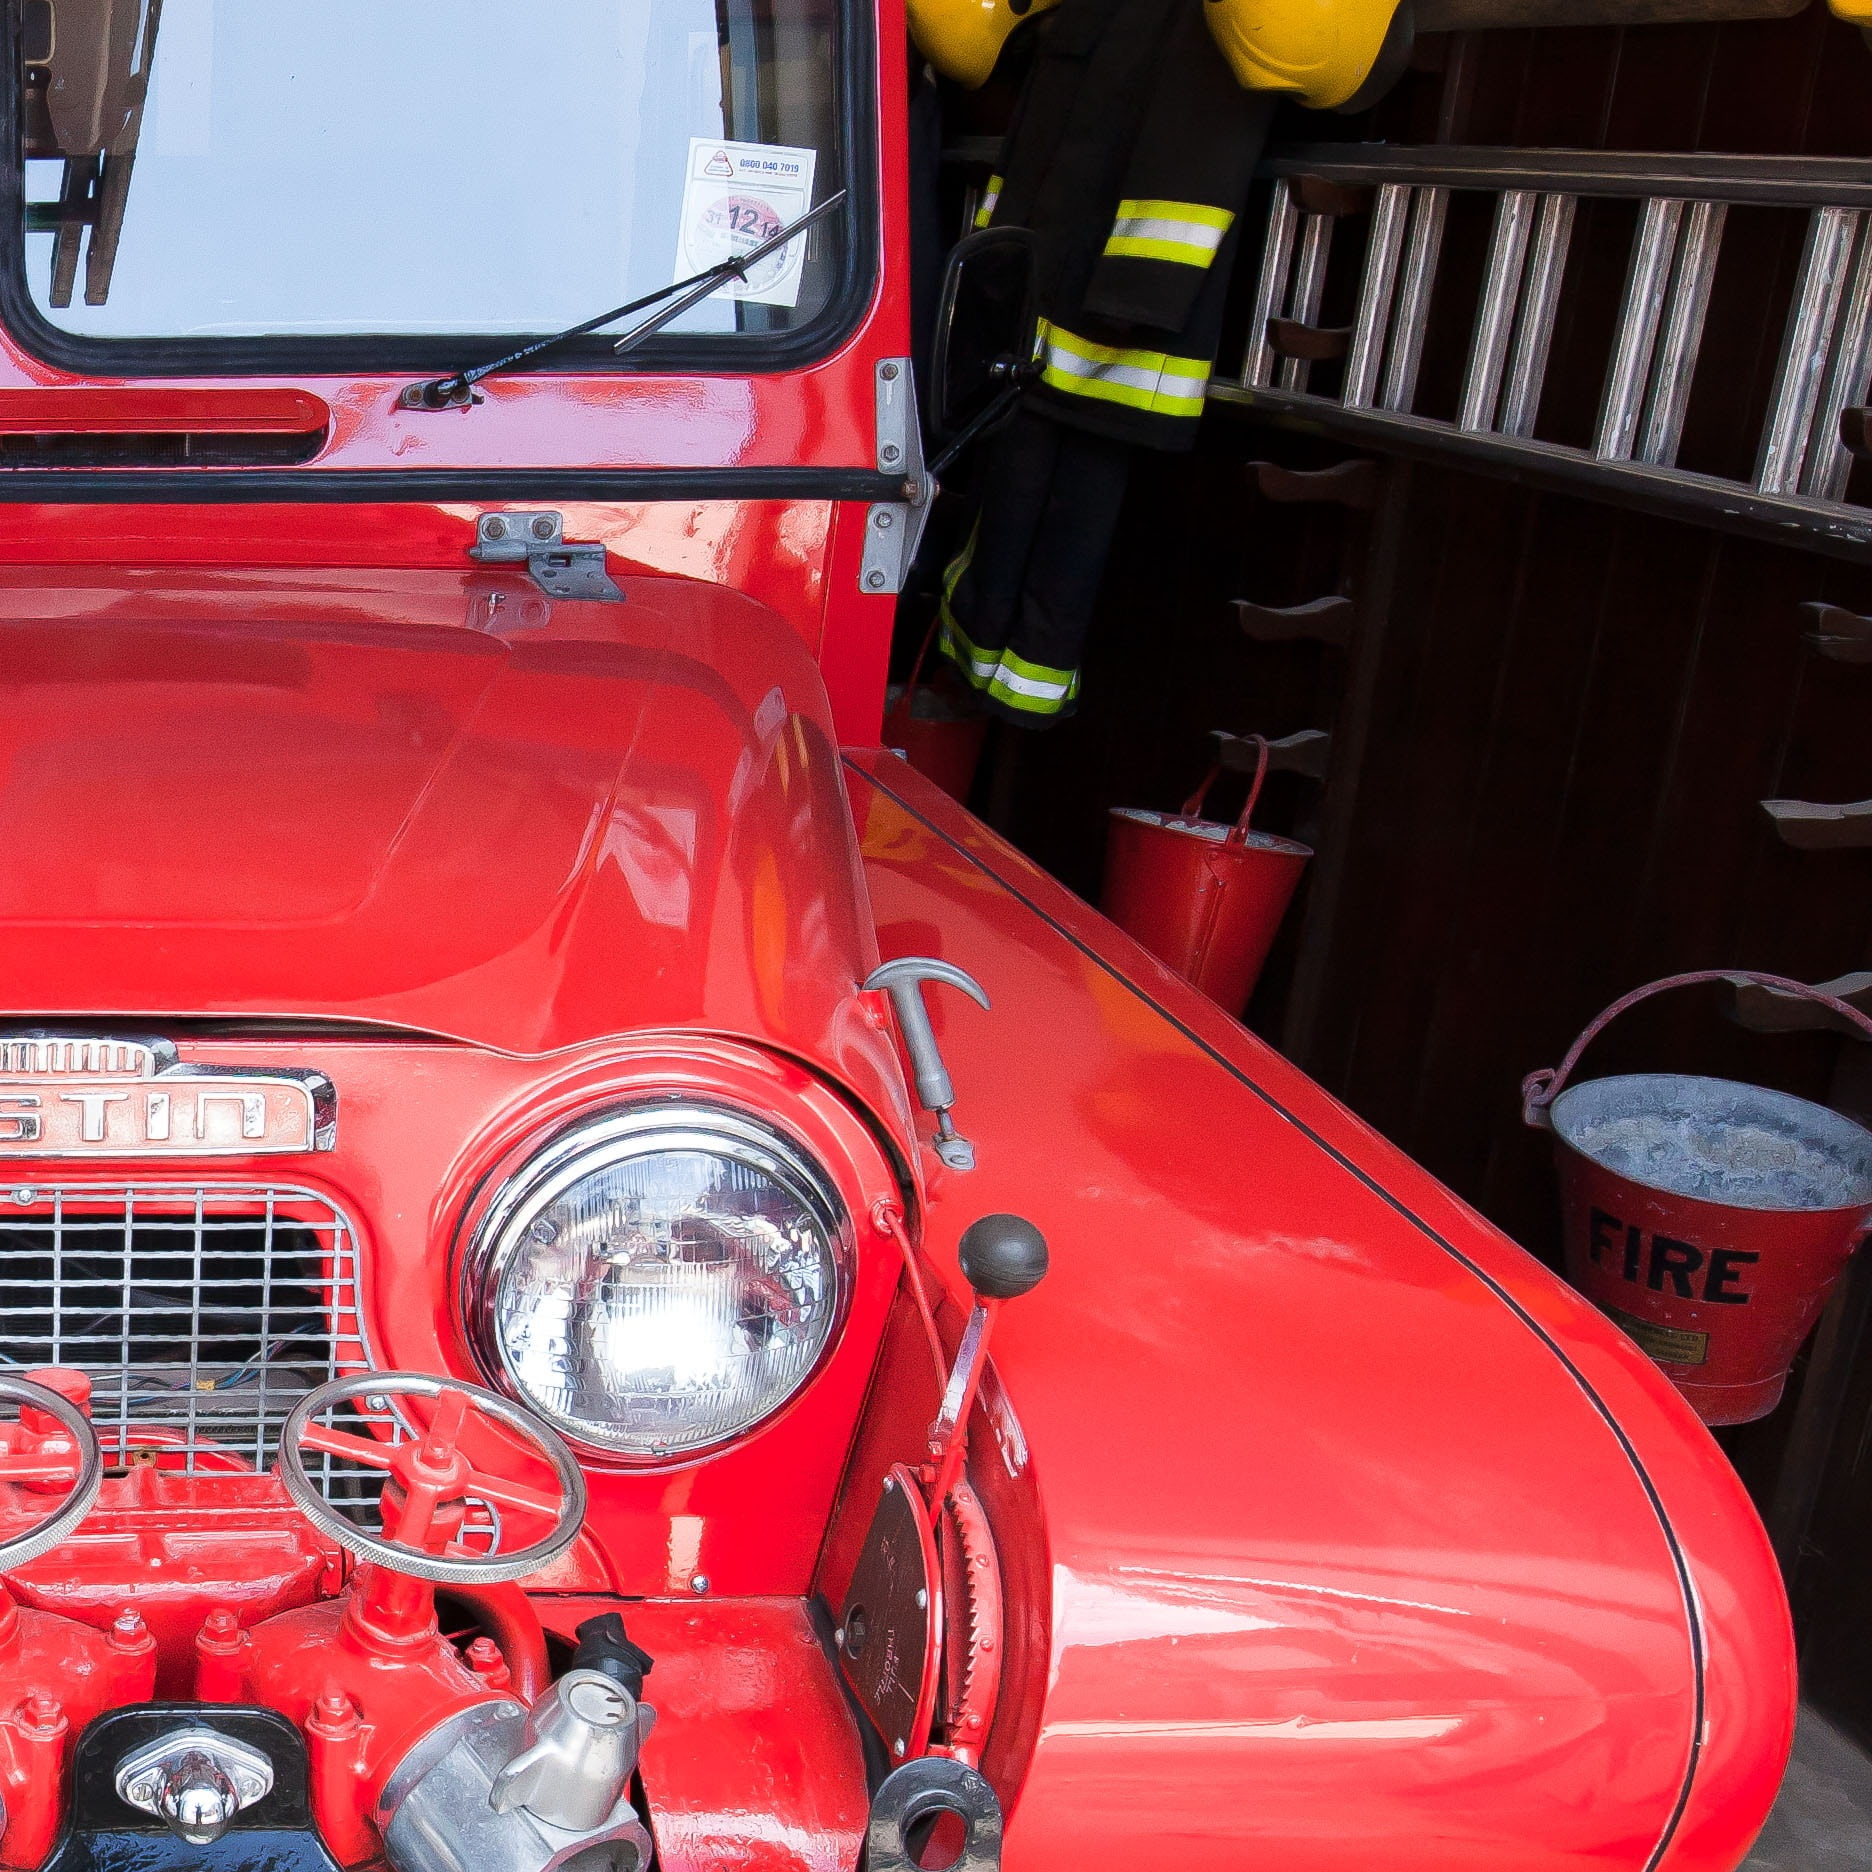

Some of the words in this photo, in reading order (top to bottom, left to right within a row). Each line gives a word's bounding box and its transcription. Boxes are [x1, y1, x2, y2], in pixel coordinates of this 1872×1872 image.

[762, 161, 778, 171] 040
[728, 205, 759, 235] 12
[1589, 1205, 1761, 1305] FIRE
